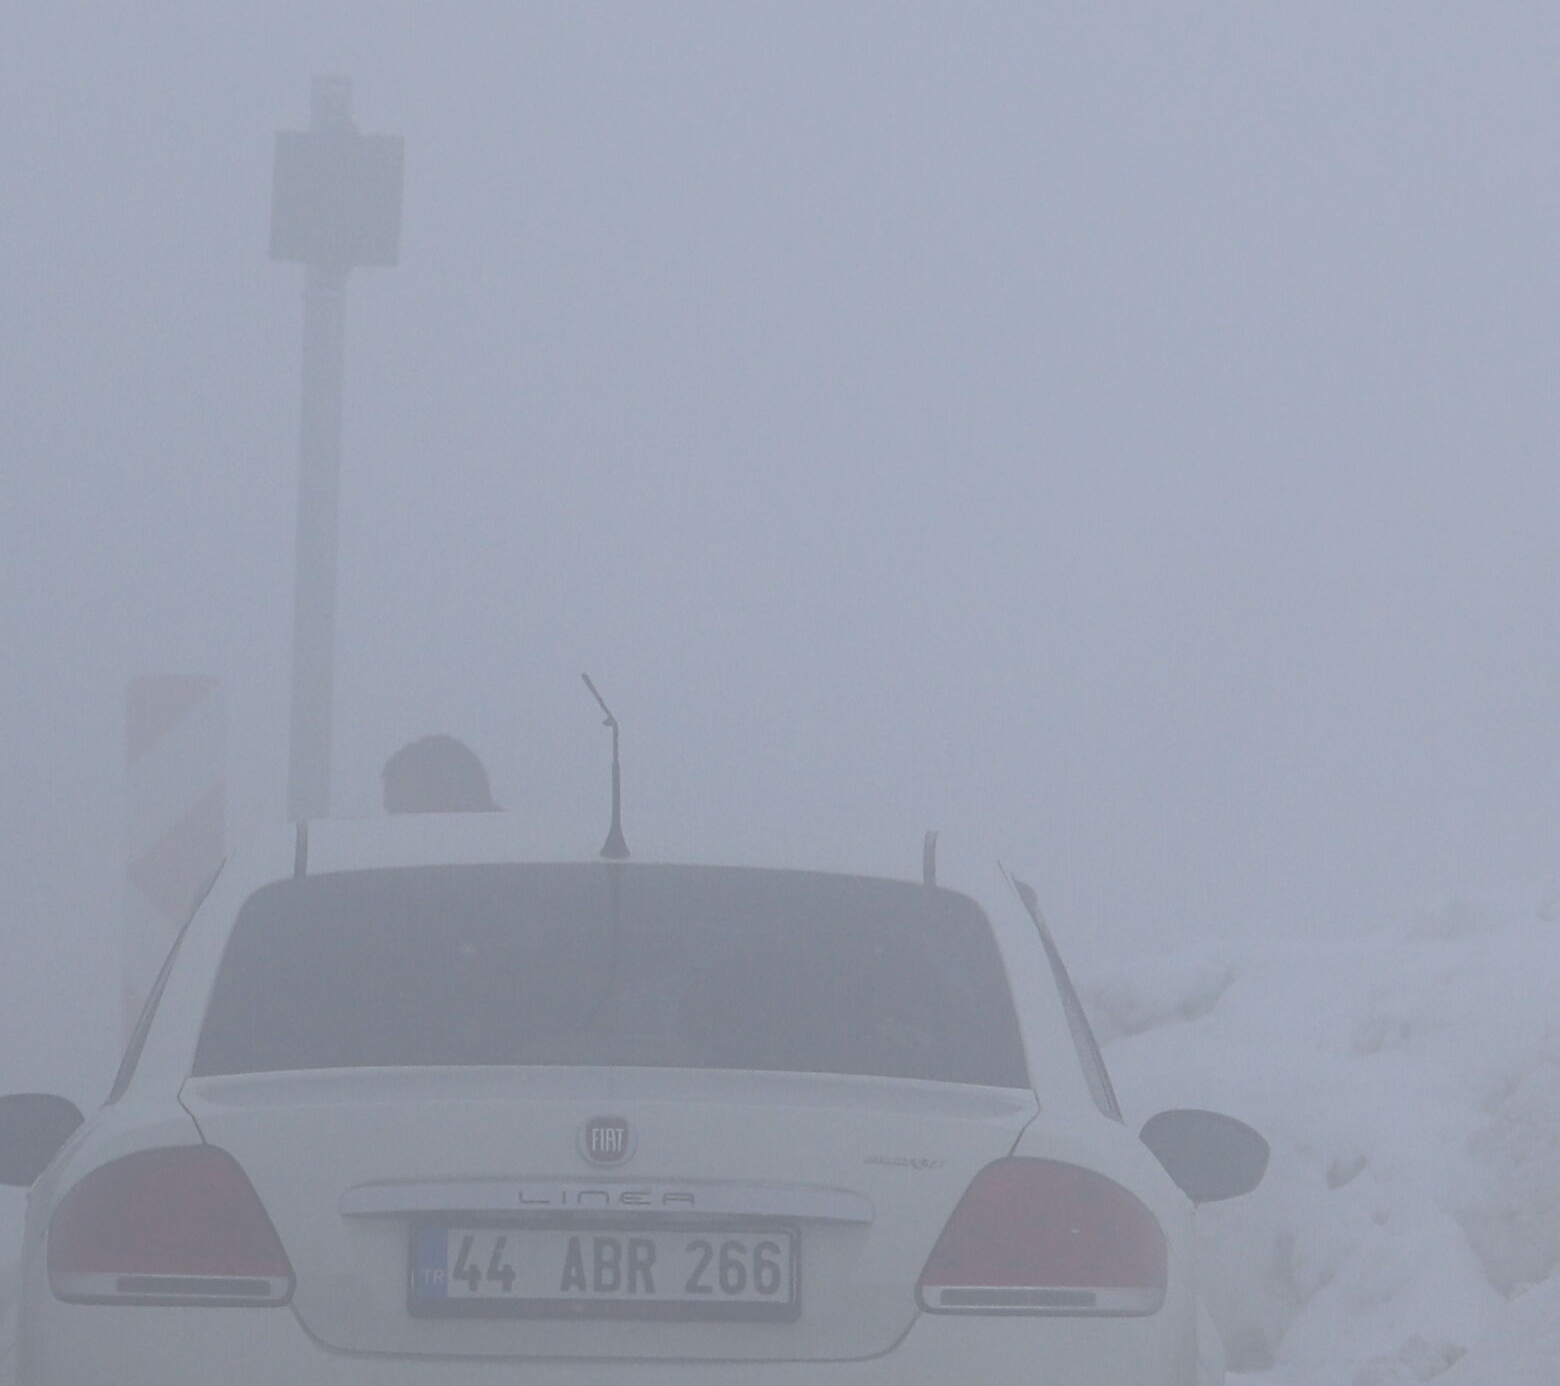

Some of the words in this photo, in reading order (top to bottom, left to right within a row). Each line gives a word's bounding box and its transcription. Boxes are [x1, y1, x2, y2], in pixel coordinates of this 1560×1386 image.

[591, 1128, 625, 1151] FIAT
[518, 1190, 695, 1206] LINEA
[452, 1235, 516, 1292] 44
[560, 1236, 656, 1294] ABR
[684, 1239, 781, 1295] 266
[421, 1268, 444, 1286] TR
